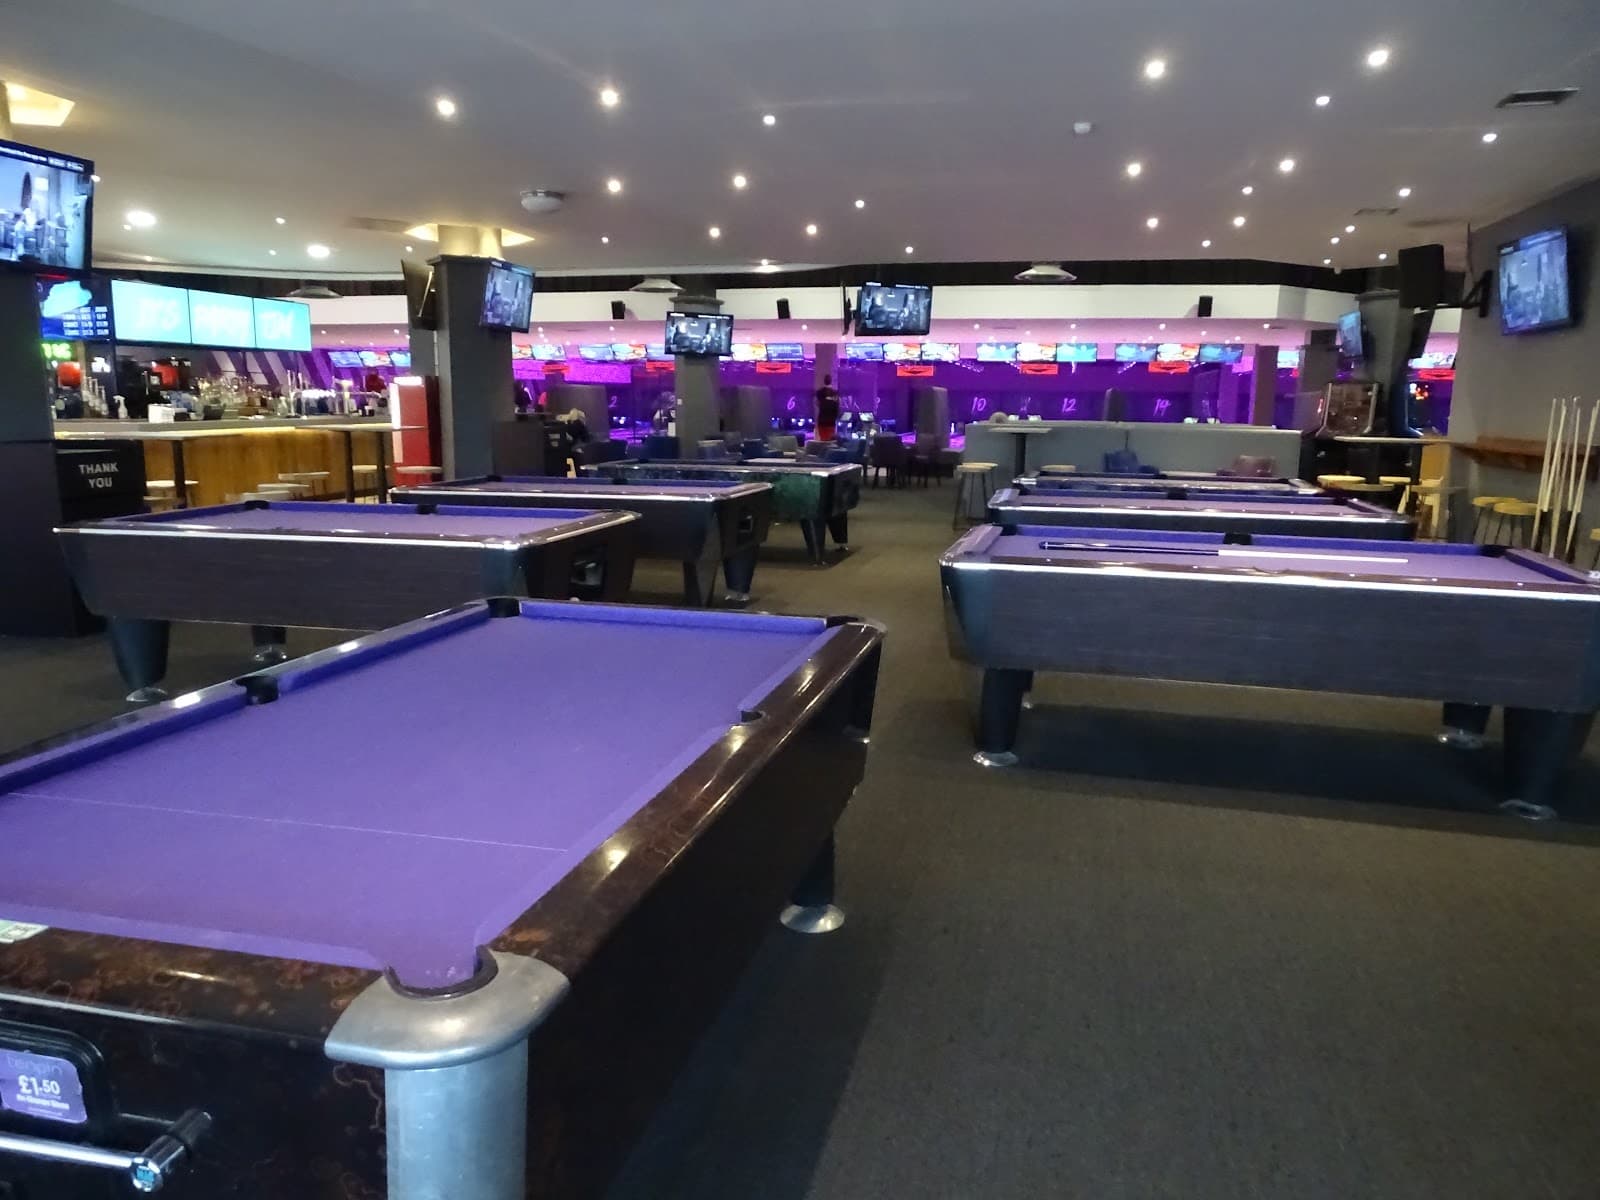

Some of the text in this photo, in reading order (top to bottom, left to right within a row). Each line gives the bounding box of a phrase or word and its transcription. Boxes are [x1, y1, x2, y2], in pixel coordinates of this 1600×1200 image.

[786, 396, 796, 411] 6
[971, 396, 987, 413] 10
[1062, 397, 1078, 413] 12
[78, 462, 119, 475] THANK
[88, 476, 113, 489] YOU
[18, 1074, 61, 1097] £1.50
